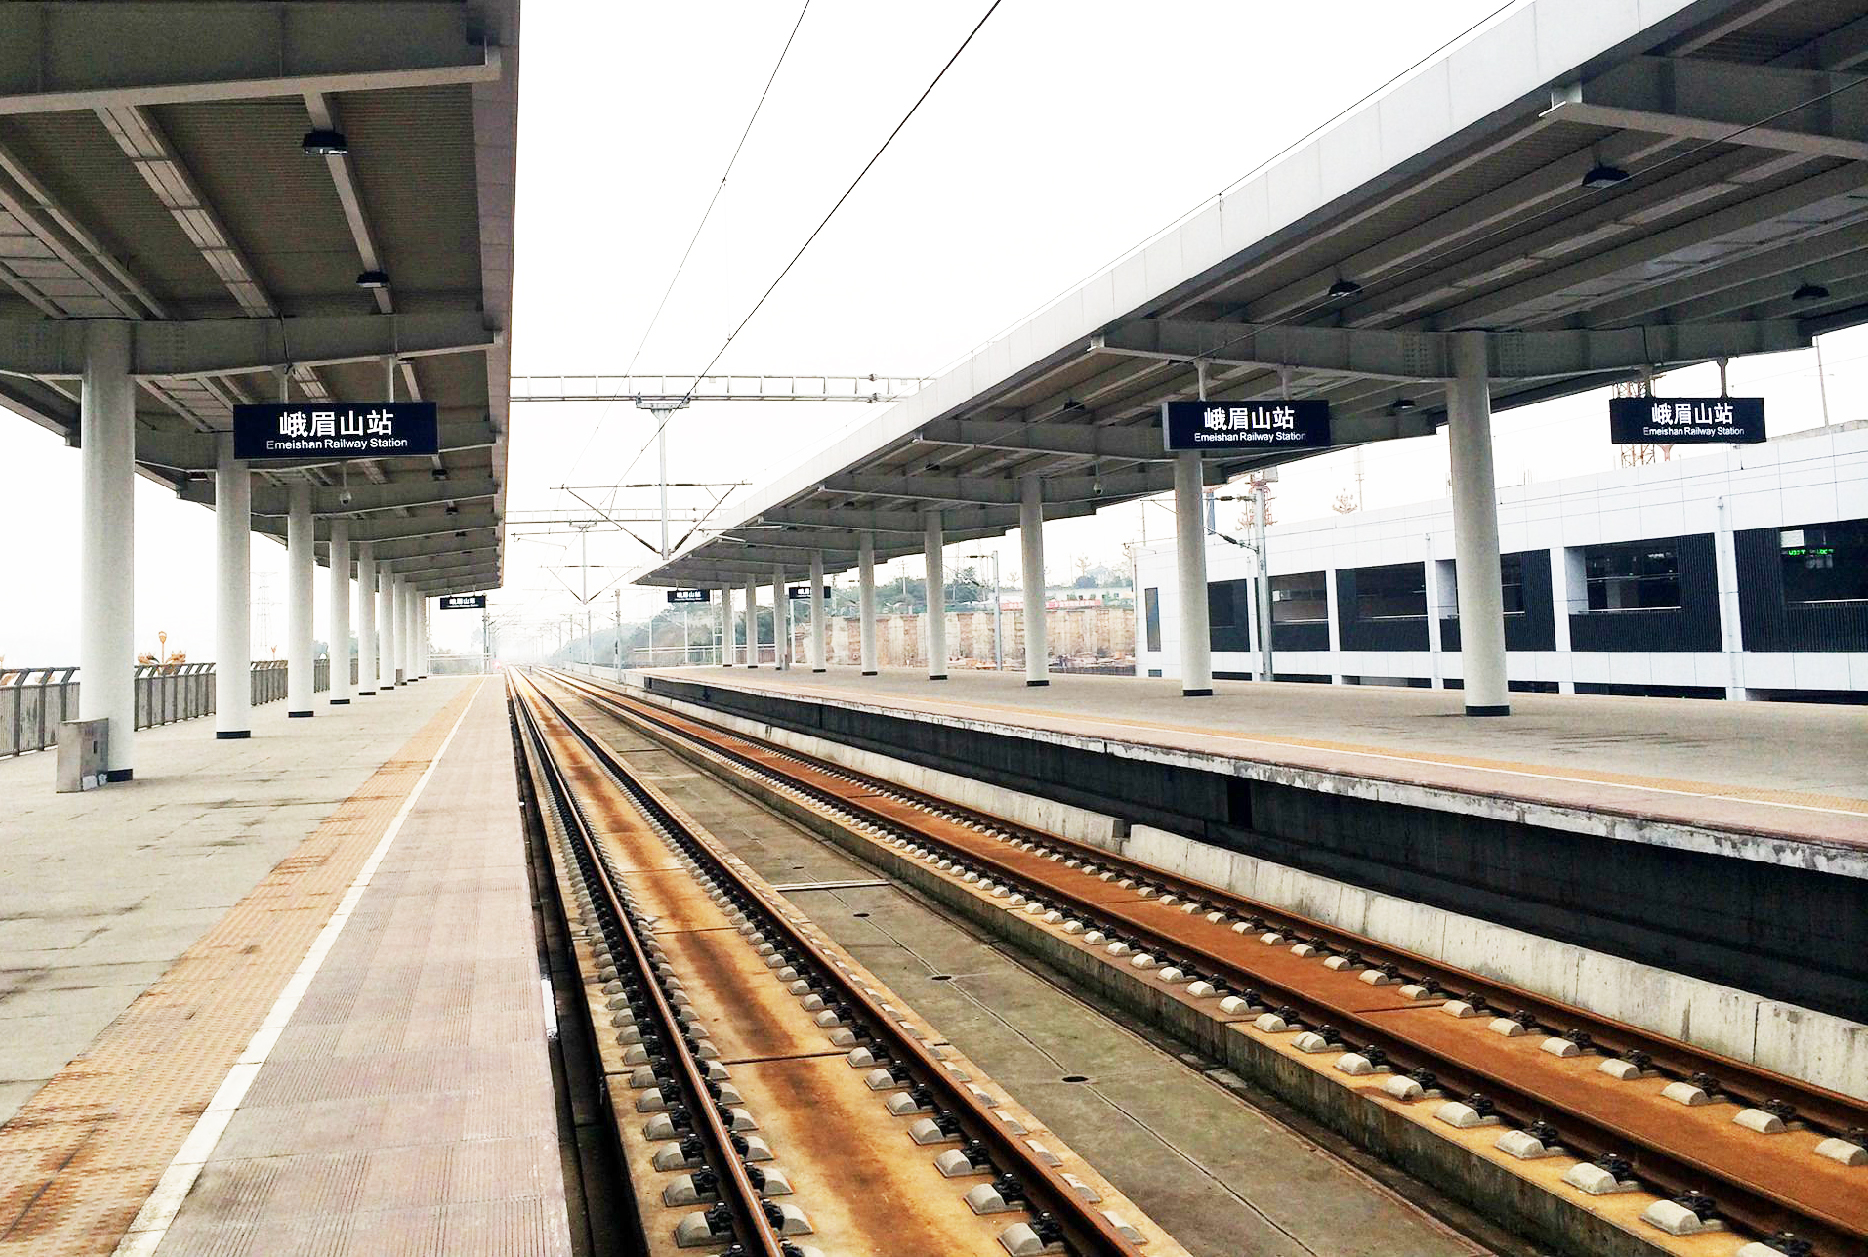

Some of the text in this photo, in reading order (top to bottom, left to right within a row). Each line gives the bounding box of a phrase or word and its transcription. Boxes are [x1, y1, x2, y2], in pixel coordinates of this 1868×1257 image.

[1204, 405, 1295, 430] 峨眉山站
[1651, 402, 1733, 425] 峨眉山站
[279, 409, 393, 437] 峨眉山站
[1643, 426, 1745, 437] Emeishan Railway Station
[265, 437, 408, 450] Emeishan Railway Station
[1194, 432, 1239, 442] Emeishan
[1239, 431, 1275, 443] Railway
